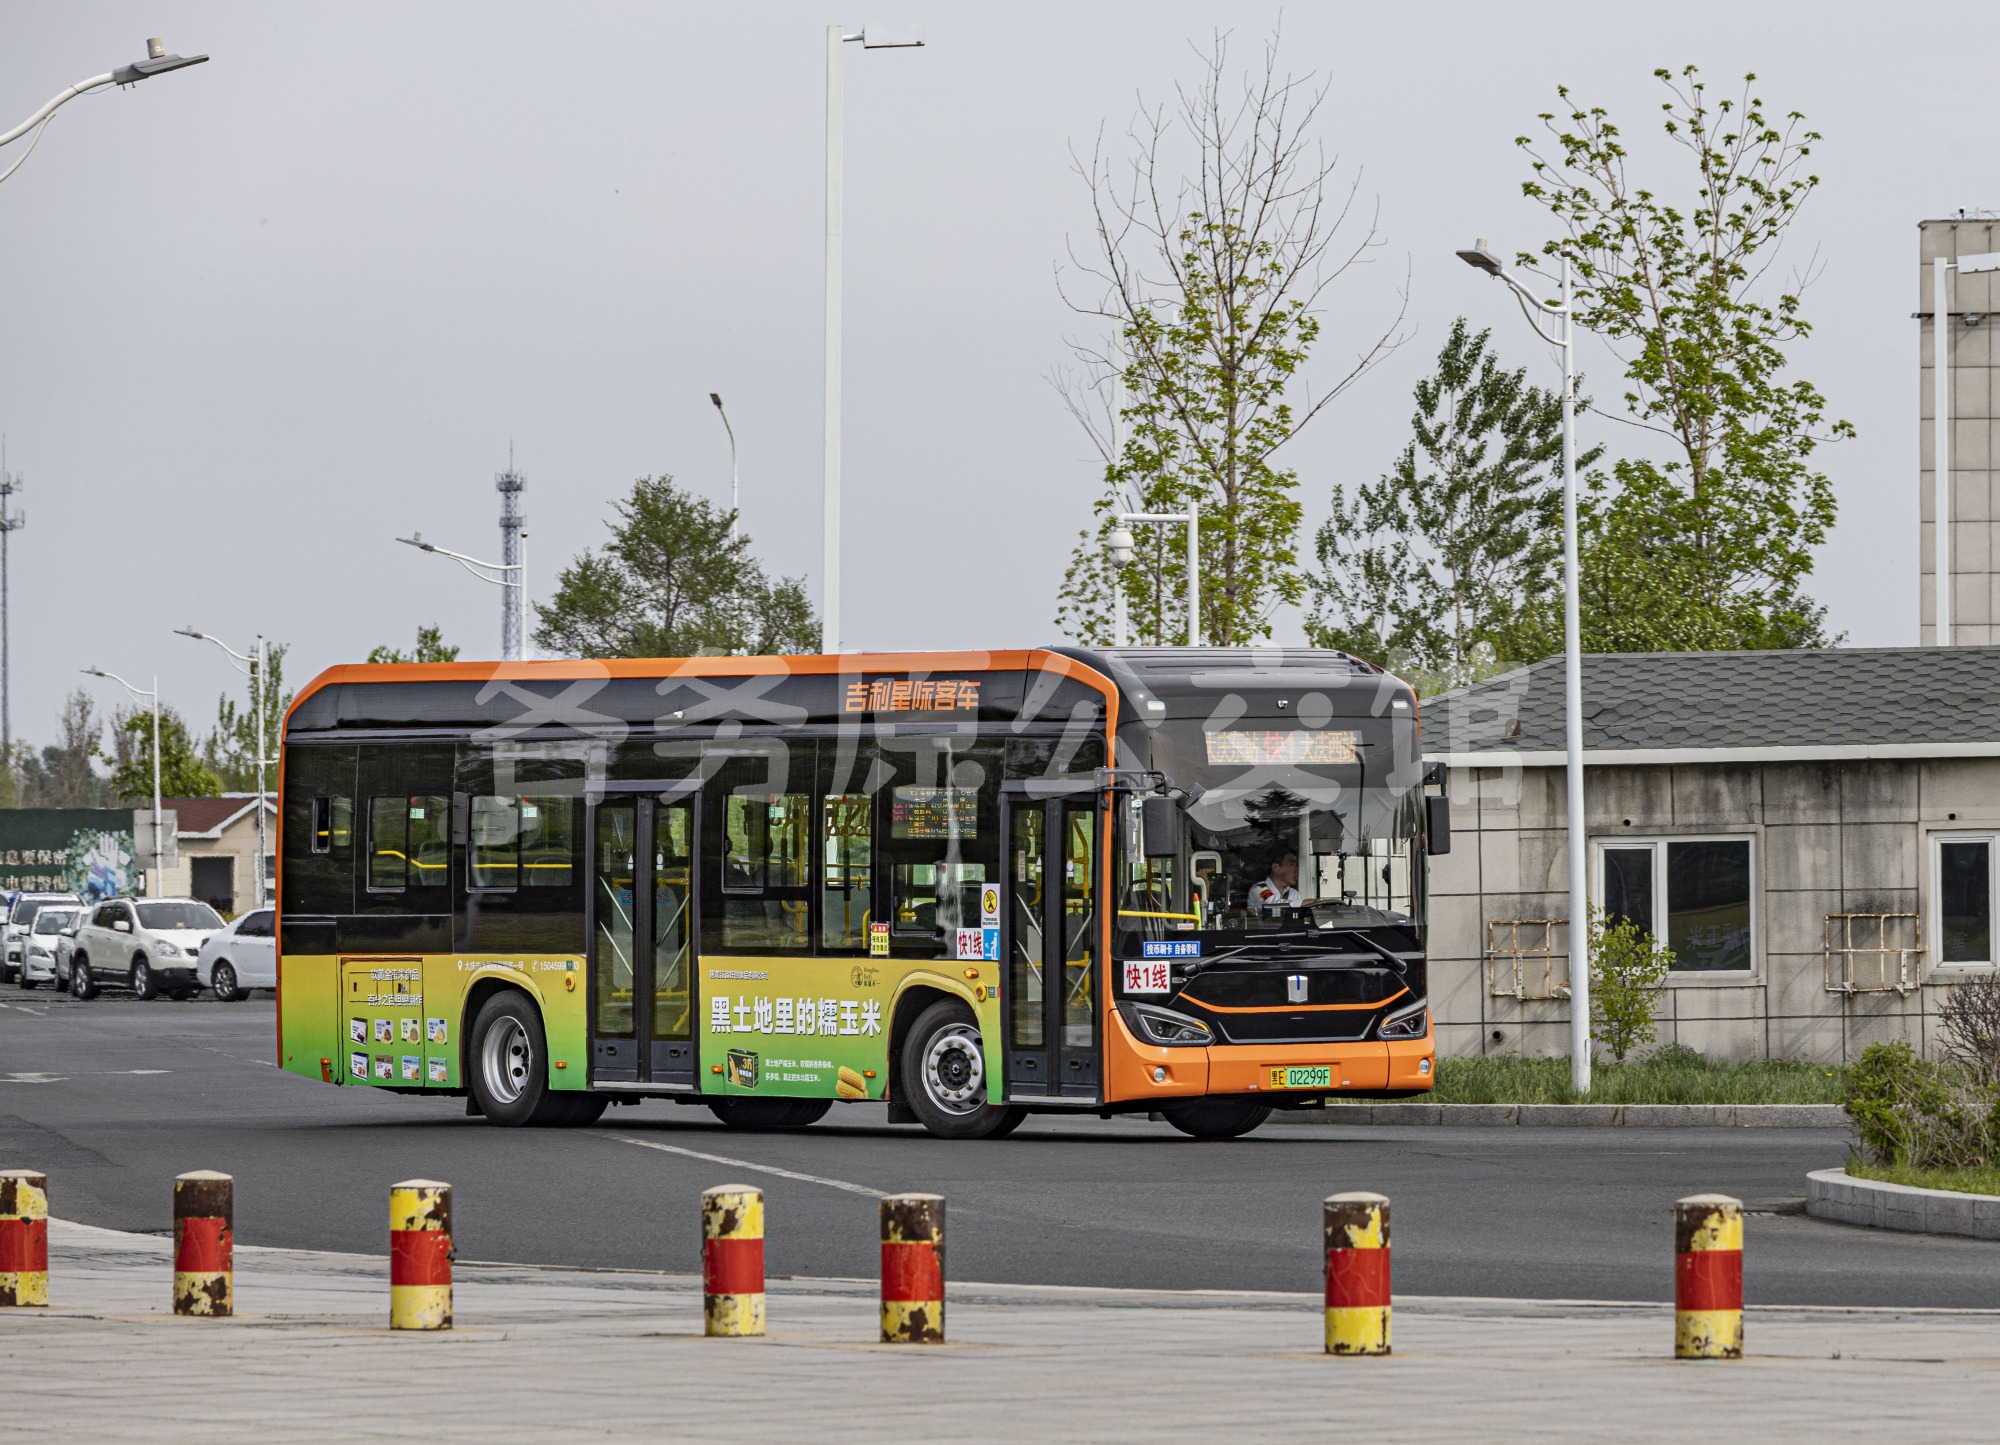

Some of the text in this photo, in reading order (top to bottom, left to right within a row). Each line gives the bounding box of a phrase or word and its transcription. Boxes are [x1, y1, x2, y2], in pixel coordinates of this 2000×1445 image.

[845, 681, 981, 713] 吉利星际客车
[958, 931, 982, 956] 快1线
[1146, 943, 1198, 955] 投币刷卡 自备零钱
[1126, 964, 1167, 990] 快1线
[711, 996, 882, 1037] 黑土地里的糯玉米
